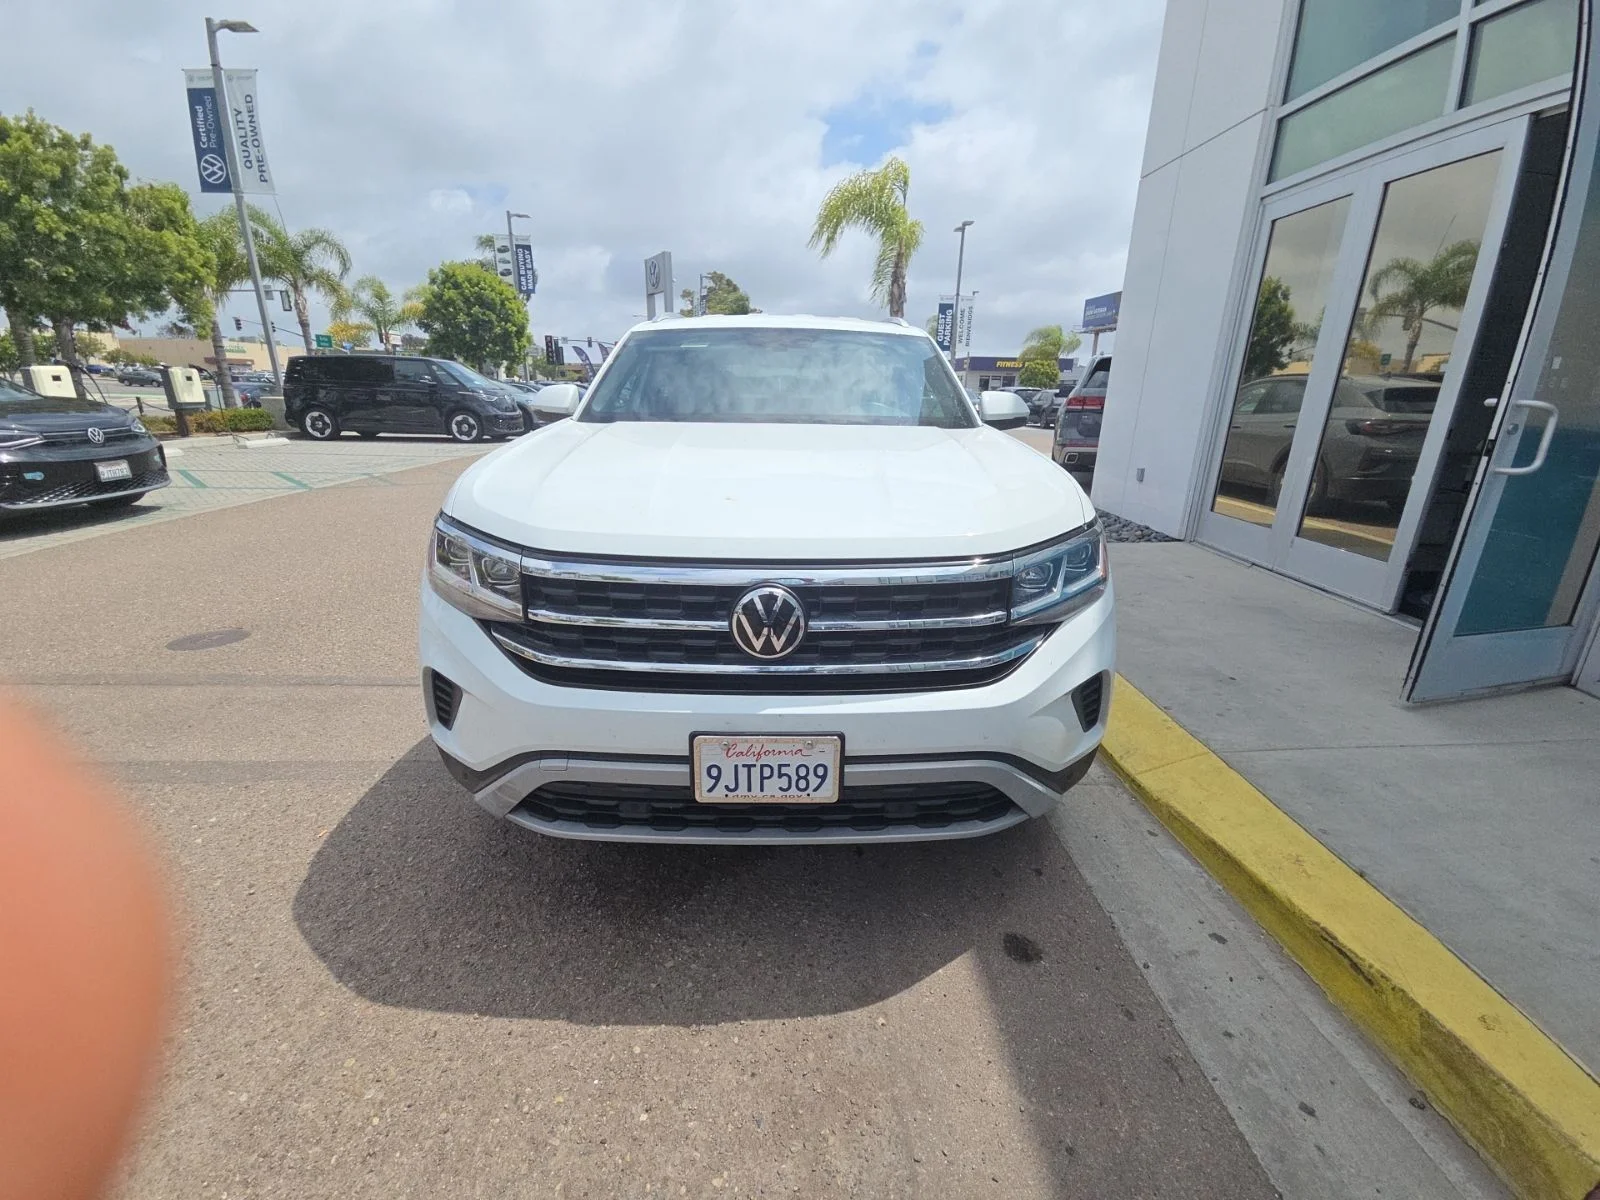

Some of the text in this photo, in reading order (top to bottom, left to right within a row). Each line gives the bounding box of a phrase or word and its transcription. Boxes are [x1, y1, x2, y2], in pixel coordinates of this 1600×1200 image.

[195, 106, 208, 148] Certified
[204, 95, 217, 148] Pre-Owned
[233, 108, 253, 170] QUALITY
[245, 94, 268, 183] PRE-OWNED
[517, 248, 526, 275] BUYING
[524, 249, 534, 290] MADE EASY
[938, 313, 946, 342] GUEST
[943, 309, 953, 346] PARKING
[958, 308, 966, 344] WELCOME
[725, 743, 812, 762] California
[706, 763, 829, 793] 9JTP589
